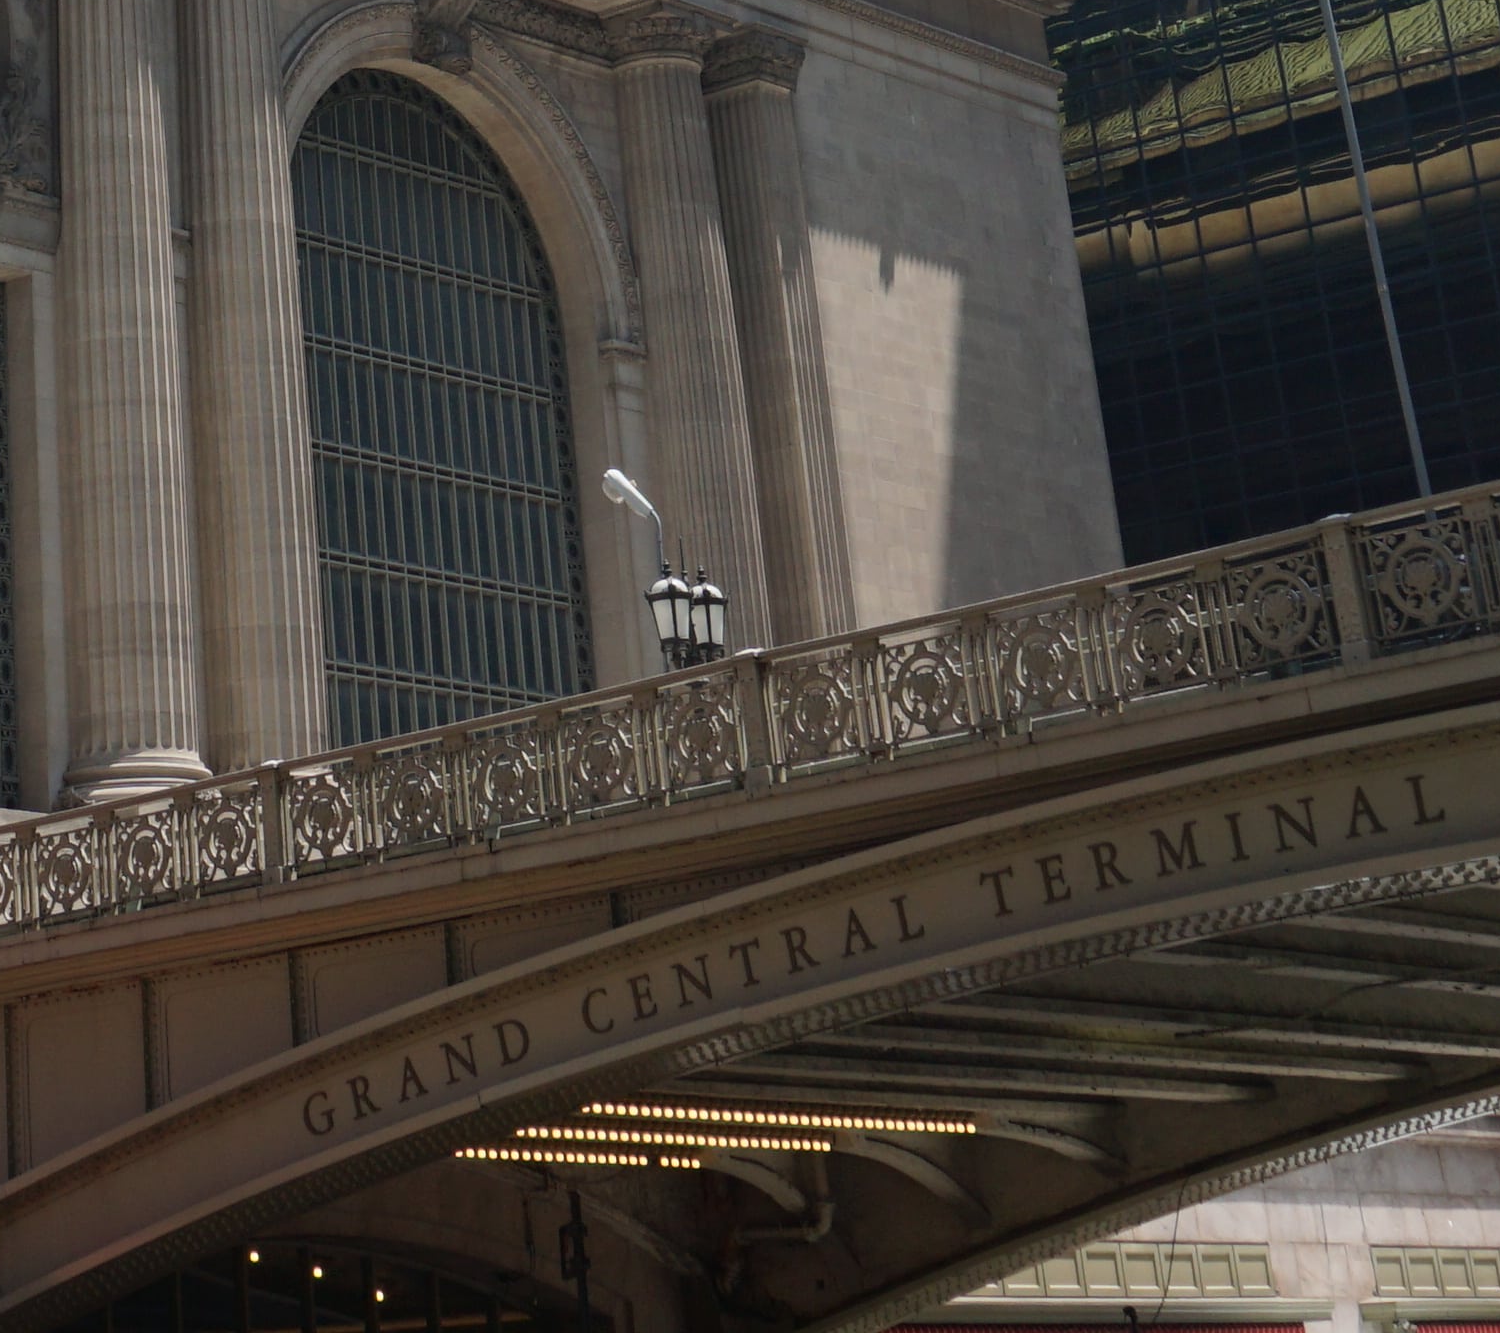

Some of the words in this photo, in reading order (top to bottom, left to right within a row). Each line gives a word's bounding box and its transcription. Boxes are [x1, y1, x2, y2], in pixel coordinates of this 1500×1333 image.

[302, 1018, 531, 1135] GRAND
[581, 893, 926, 1035] CENTRAL
[979, 774, 1446, 919] TERMINAL
